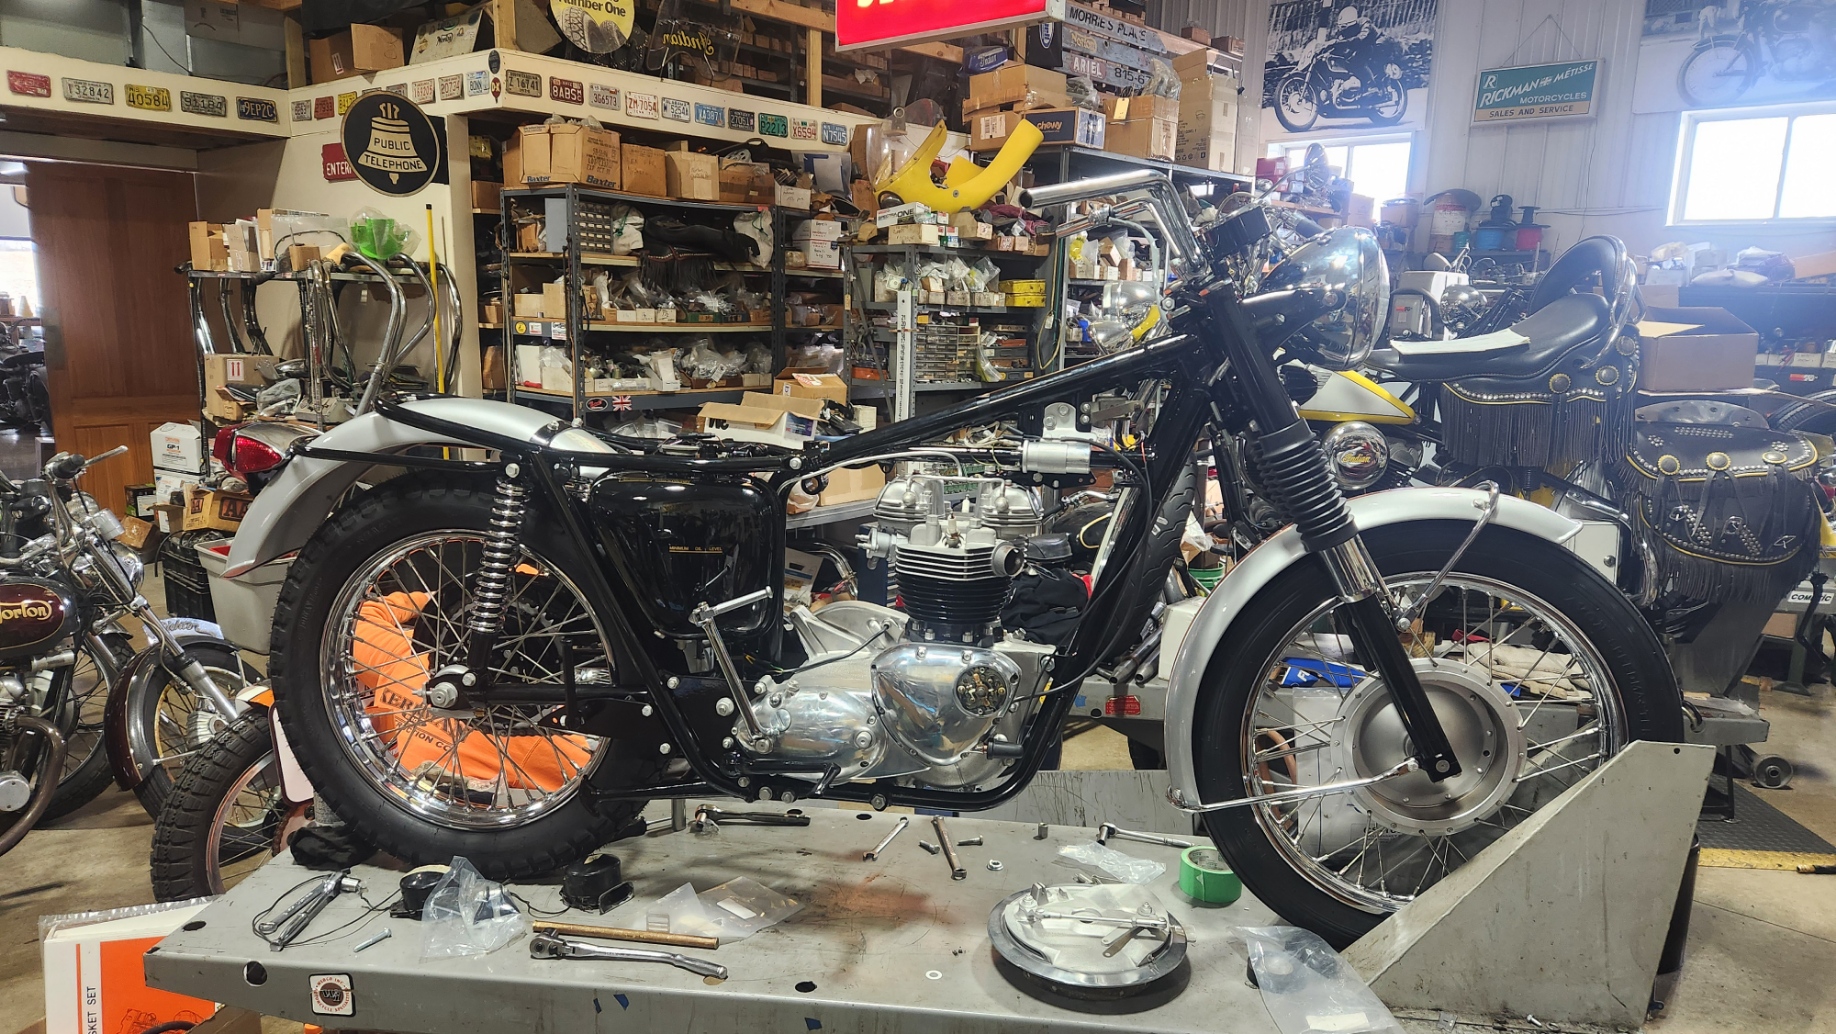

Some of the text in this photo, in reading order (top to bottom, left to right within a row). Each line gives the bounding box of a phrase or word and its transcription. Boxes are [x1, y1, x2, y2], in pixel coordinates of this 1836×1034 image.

[559, 0, 626, 17] umber One
[1073, 57, 1103, 79] ARIEL
[440, 80, 460, 94] 20734
[516, 78, 538, 91] 16741
[1480, 62, 1594, 108] RICKMAN MÉTISSE
[1484, 74, 1497, 89] R
[552, 85, 577, 100] 8ABS
[1520, 91, 1587, 104] MOTORCYCLES
[128, 93, 169, 107] 40584
[628, 97, 657, 112] ZM-7054
[1489, 104, 1574, 118] SALES AND SERVICE
[760, 120, 787, 135] P2213
[792, 126, 817, 139] X6594
[823, 129, 847, 144] N7545
[374, 137, 411, 151] PUBLIC
[363, 153, 423, 171] TELEPHONE
[526, 175, 551, 183] Baxter
[586, 174, 617, 188] Baxter
[897, 208, 915, 218] ONE
[1342, 452, 1371, 464] Indian
[1791, 593, 1832, 602] COMIC
[86, 986, 97, 1005] SET
